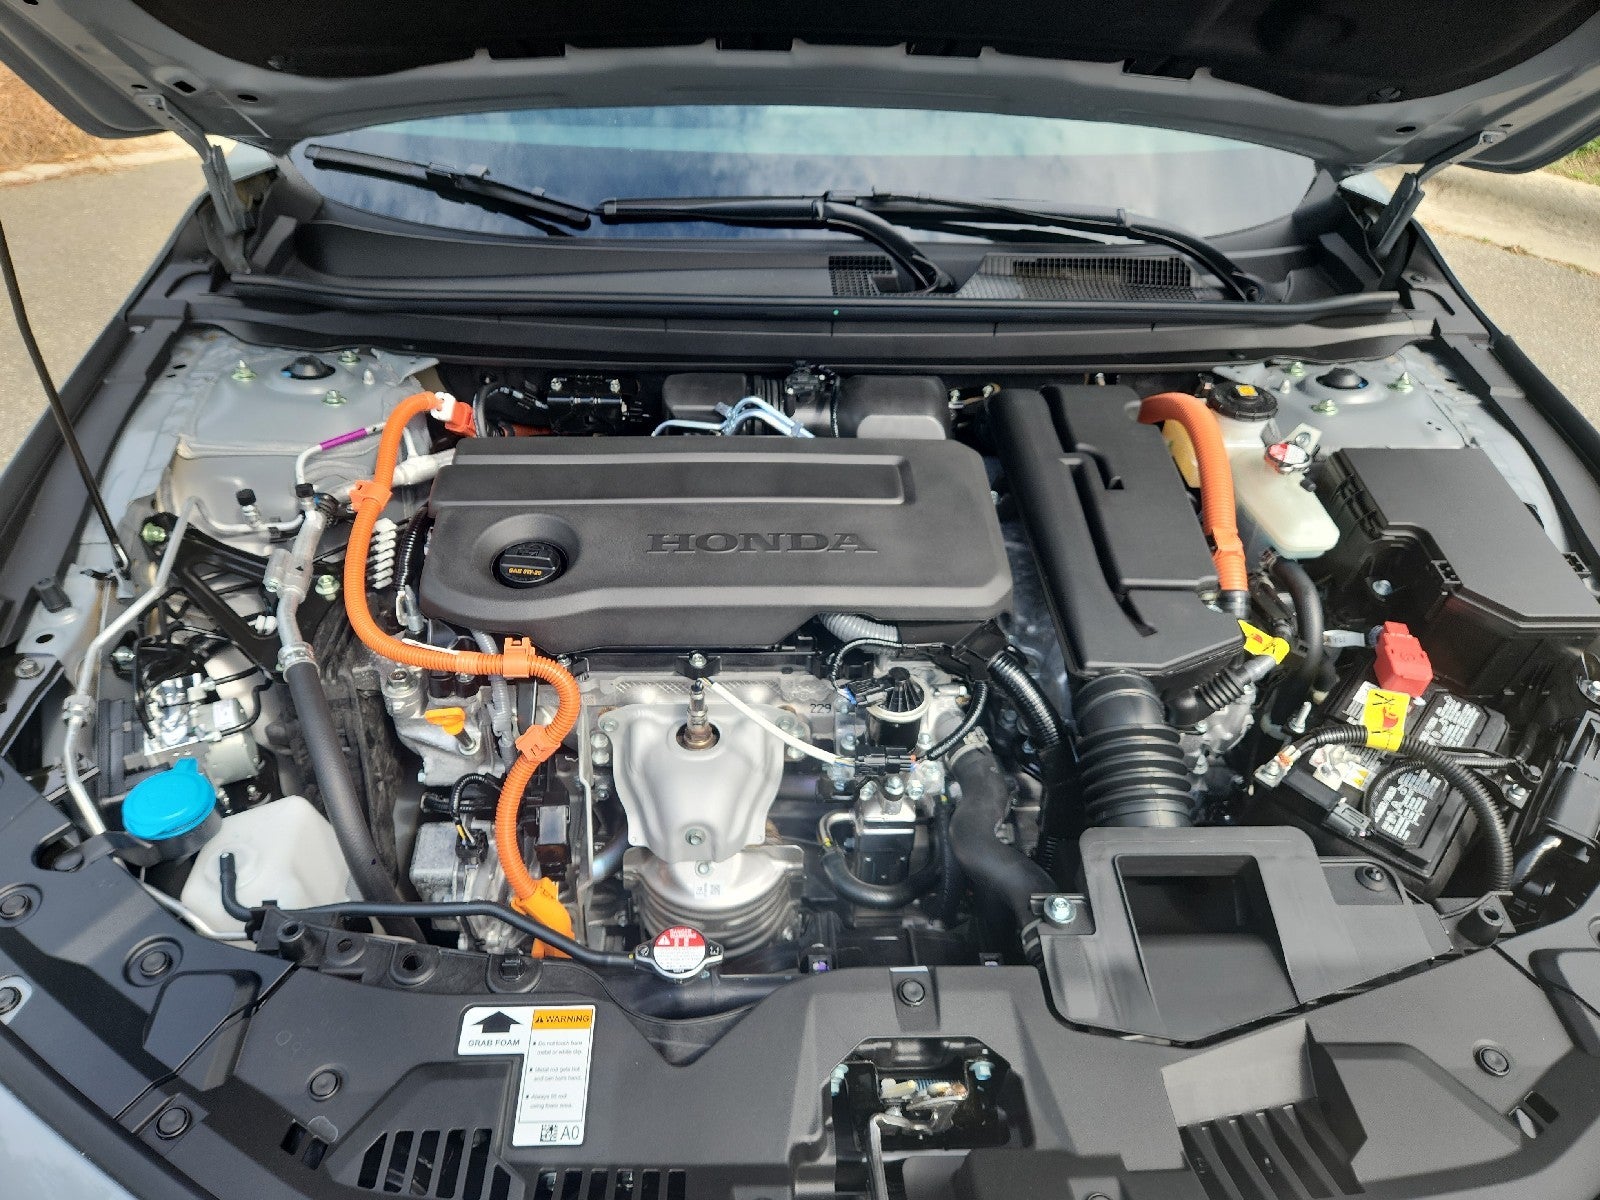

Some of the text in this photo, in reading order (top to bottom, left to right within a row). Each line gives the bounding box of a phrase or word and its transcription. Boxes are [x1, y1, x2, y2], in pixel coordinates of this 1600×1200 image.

[646, 531, 878, 555] HONDA
[810, 703, 832, 714] 229
[546, 1014, 590, 1023] WARNING
[468, 1039, 520, 1047] GRAB FOAM
[560, 1125, 580, 1140] A0
